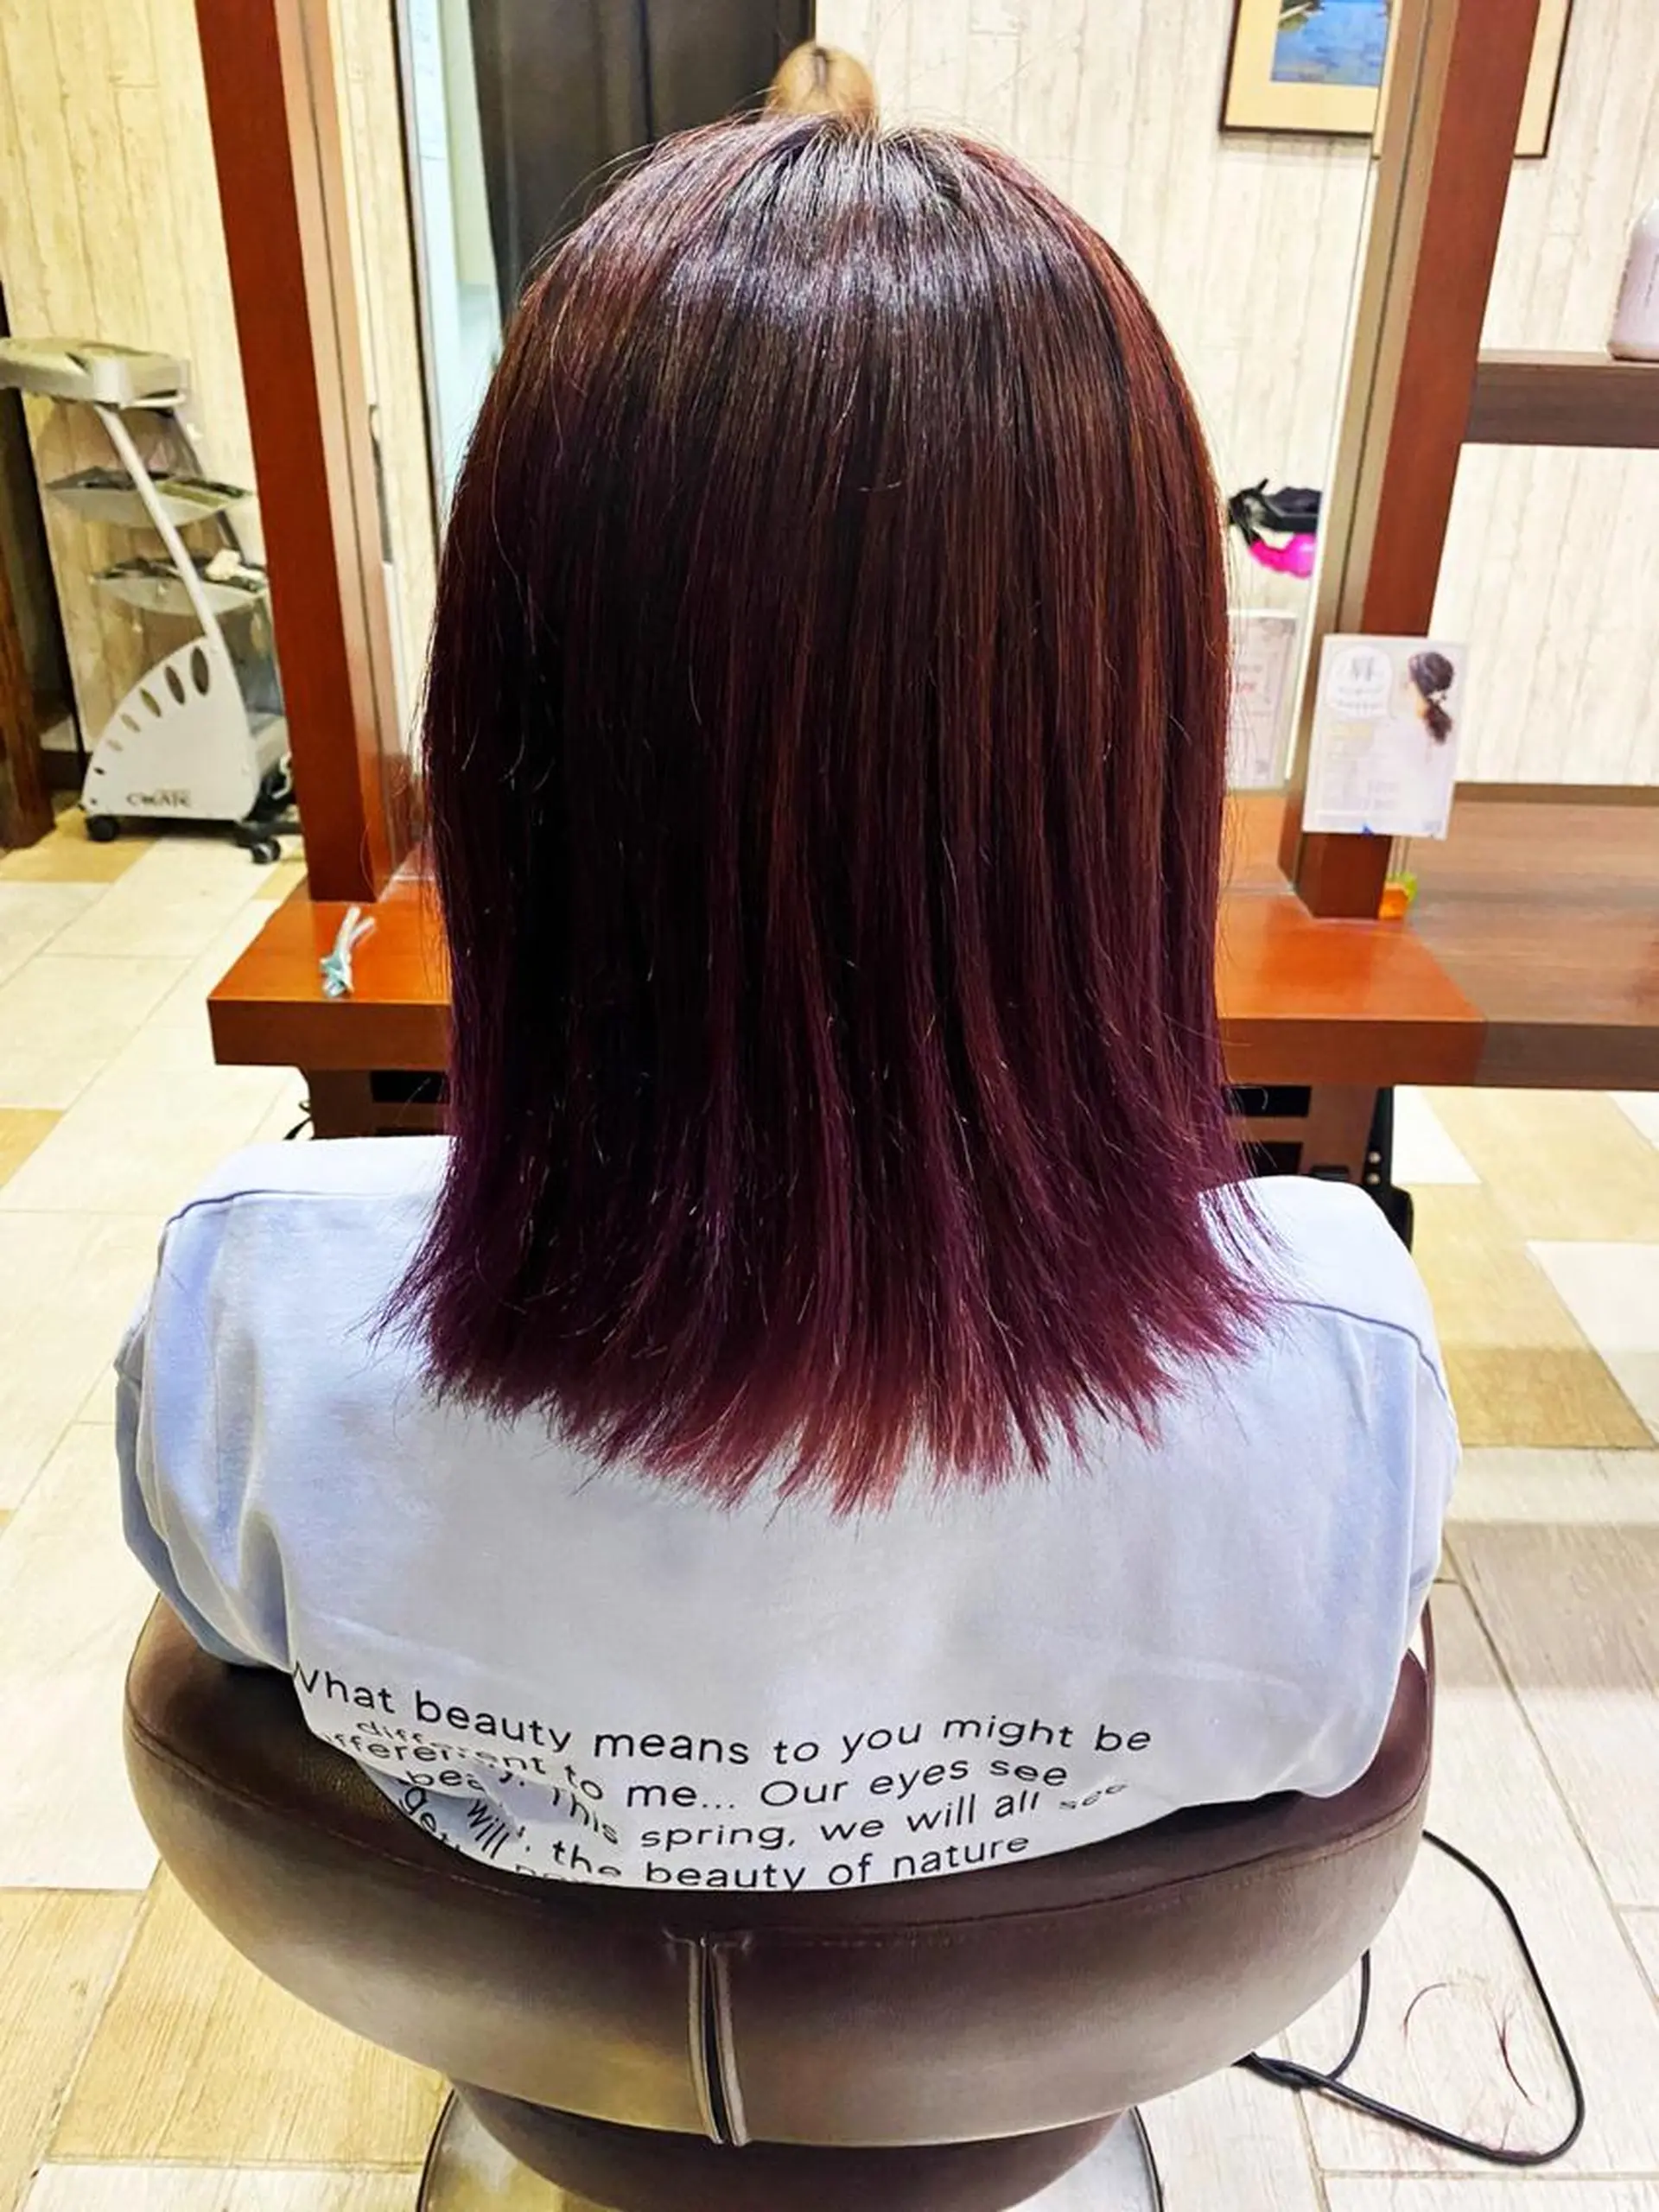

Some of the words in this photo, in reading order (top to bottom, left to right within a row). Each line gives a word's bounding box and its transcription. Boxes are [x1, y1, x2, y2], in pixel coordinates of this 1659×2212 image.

[415, 1689, 572, 1753] beauty
[594, 1733, 750, 1765] means
[773, 1740, 819, 1765] to
[841, 1723, 922, 1764] you
[943, 1716, 1075, 1747] might
[1094, 1723, 1152, 1752] be
[563, 1764, 604, 1801] to
[760, 1780, 849, 1807] Our
[869, 1759, 969, 1800] eyes
[989, 1759, 1069, 1788] see
[641, 1821, 796, 1853] spring,
[820, 1818, 886, 1842] we
[906, 1792, 977, 1833] will
[995, 1789, 1040, 1819] all
[645, 1859, 807, 1890] beauty
[828, 1852, 874, 1886] of
[893, 1836, 1030, 1879] nature
